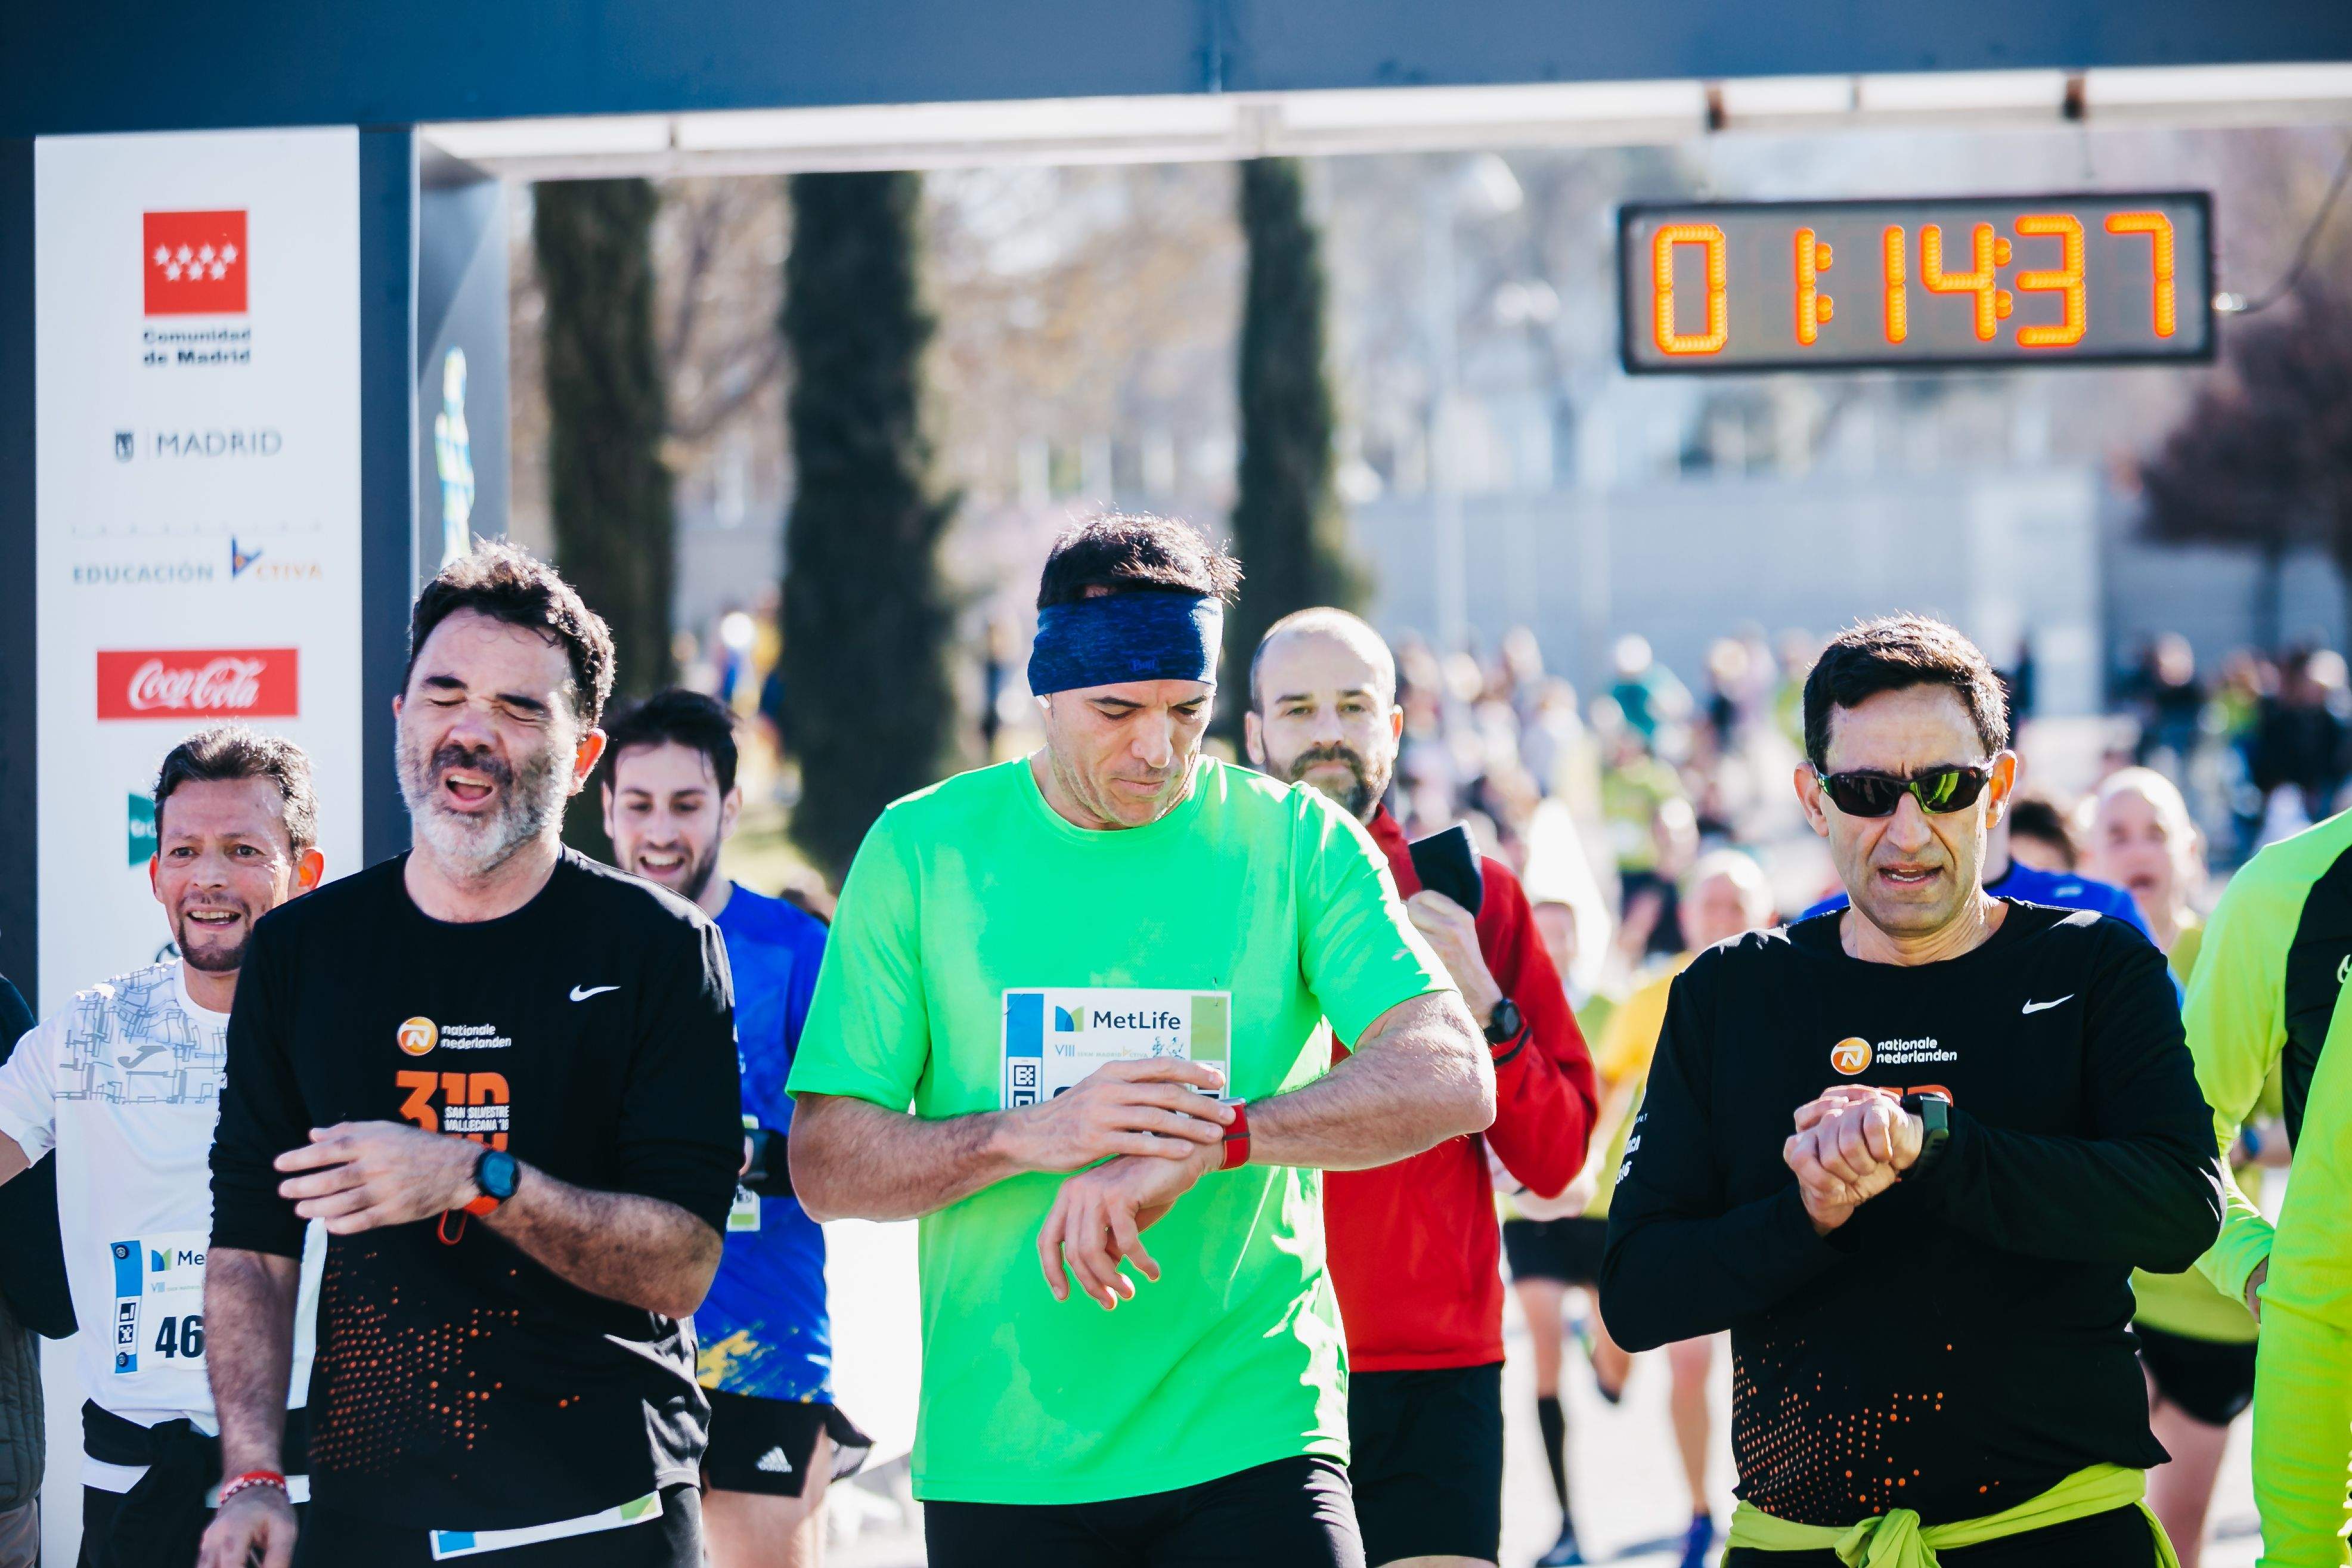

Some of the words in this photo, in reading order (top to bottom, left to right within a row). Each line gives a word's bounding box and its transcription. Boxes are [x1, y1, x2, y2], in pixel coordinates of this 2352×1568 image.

[143, 328, 251, 344] Comunidad
[143, 350, 167, 365] de
[176, 348, 250, 365] Madrid
[157, 430, 283, 458] MADRID
[1093, 1011, 1181, 1030] MetLife
[441, 1024, 496, 1036] nationale
[441, 1036, 512, 1050] nederlanden
[1877, 1037, 1938, 1051] nationale
[1055, 1044, 1075, 1057] VIII
[1876, 1049, 1957, 1064] nederlanden
[445, 1106, 466, 1118] SAN
[467, 1105, 510, 1118] SILVESTRE
[444, 1119, 498, 1132] VALLECANA
